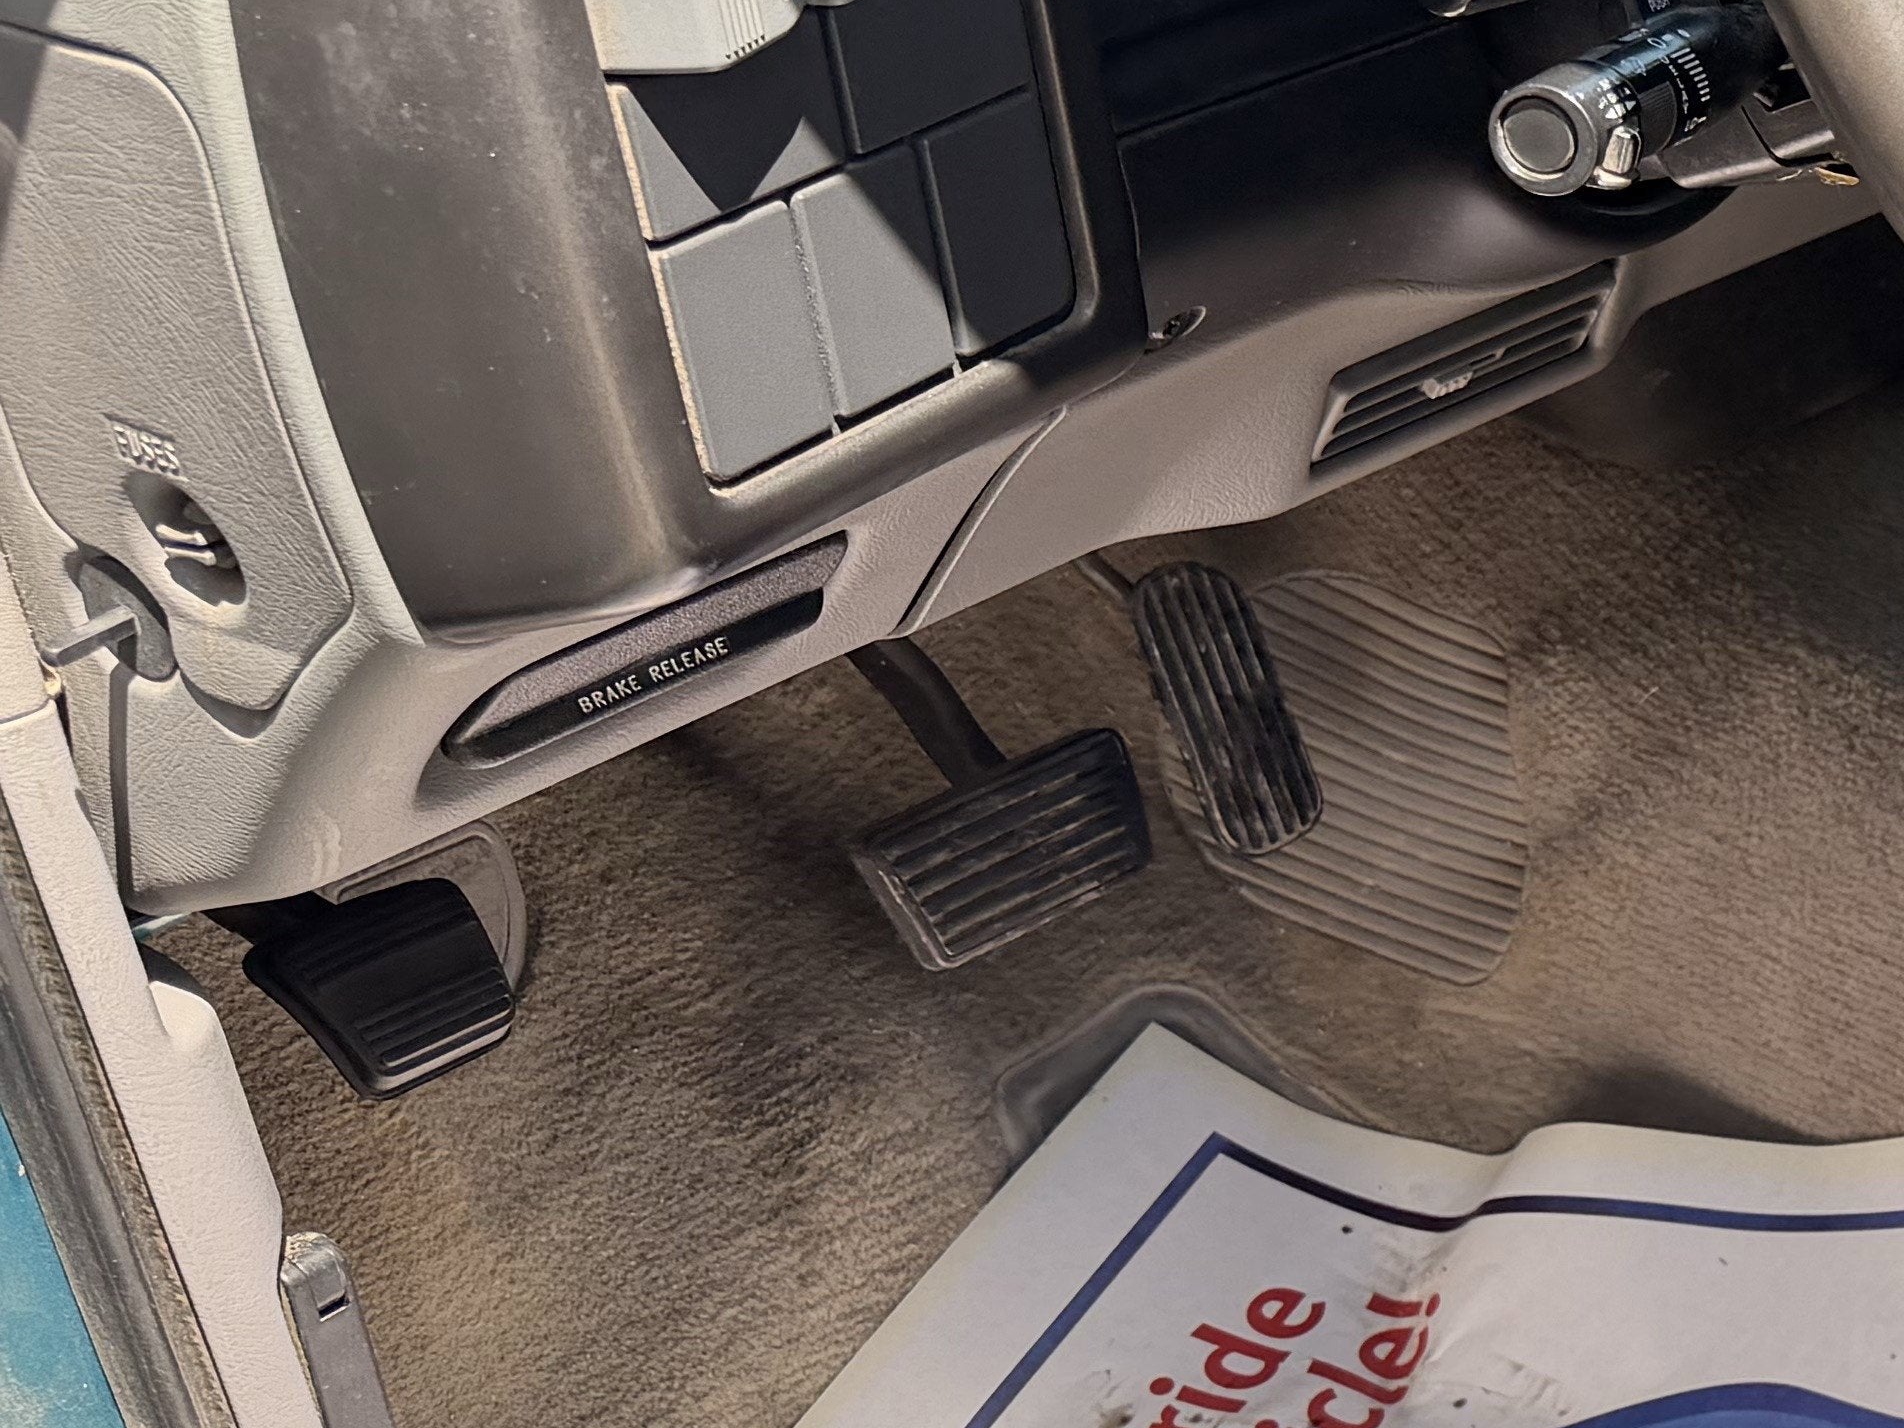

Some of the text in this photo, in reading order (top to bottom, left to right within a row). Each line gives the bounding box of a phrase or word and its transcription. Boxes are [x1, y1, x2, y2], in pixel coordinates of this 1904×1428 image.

[112, 424, 181, 477] FUSES
[578, 637, 729, 714] BRAKE RELEASE
